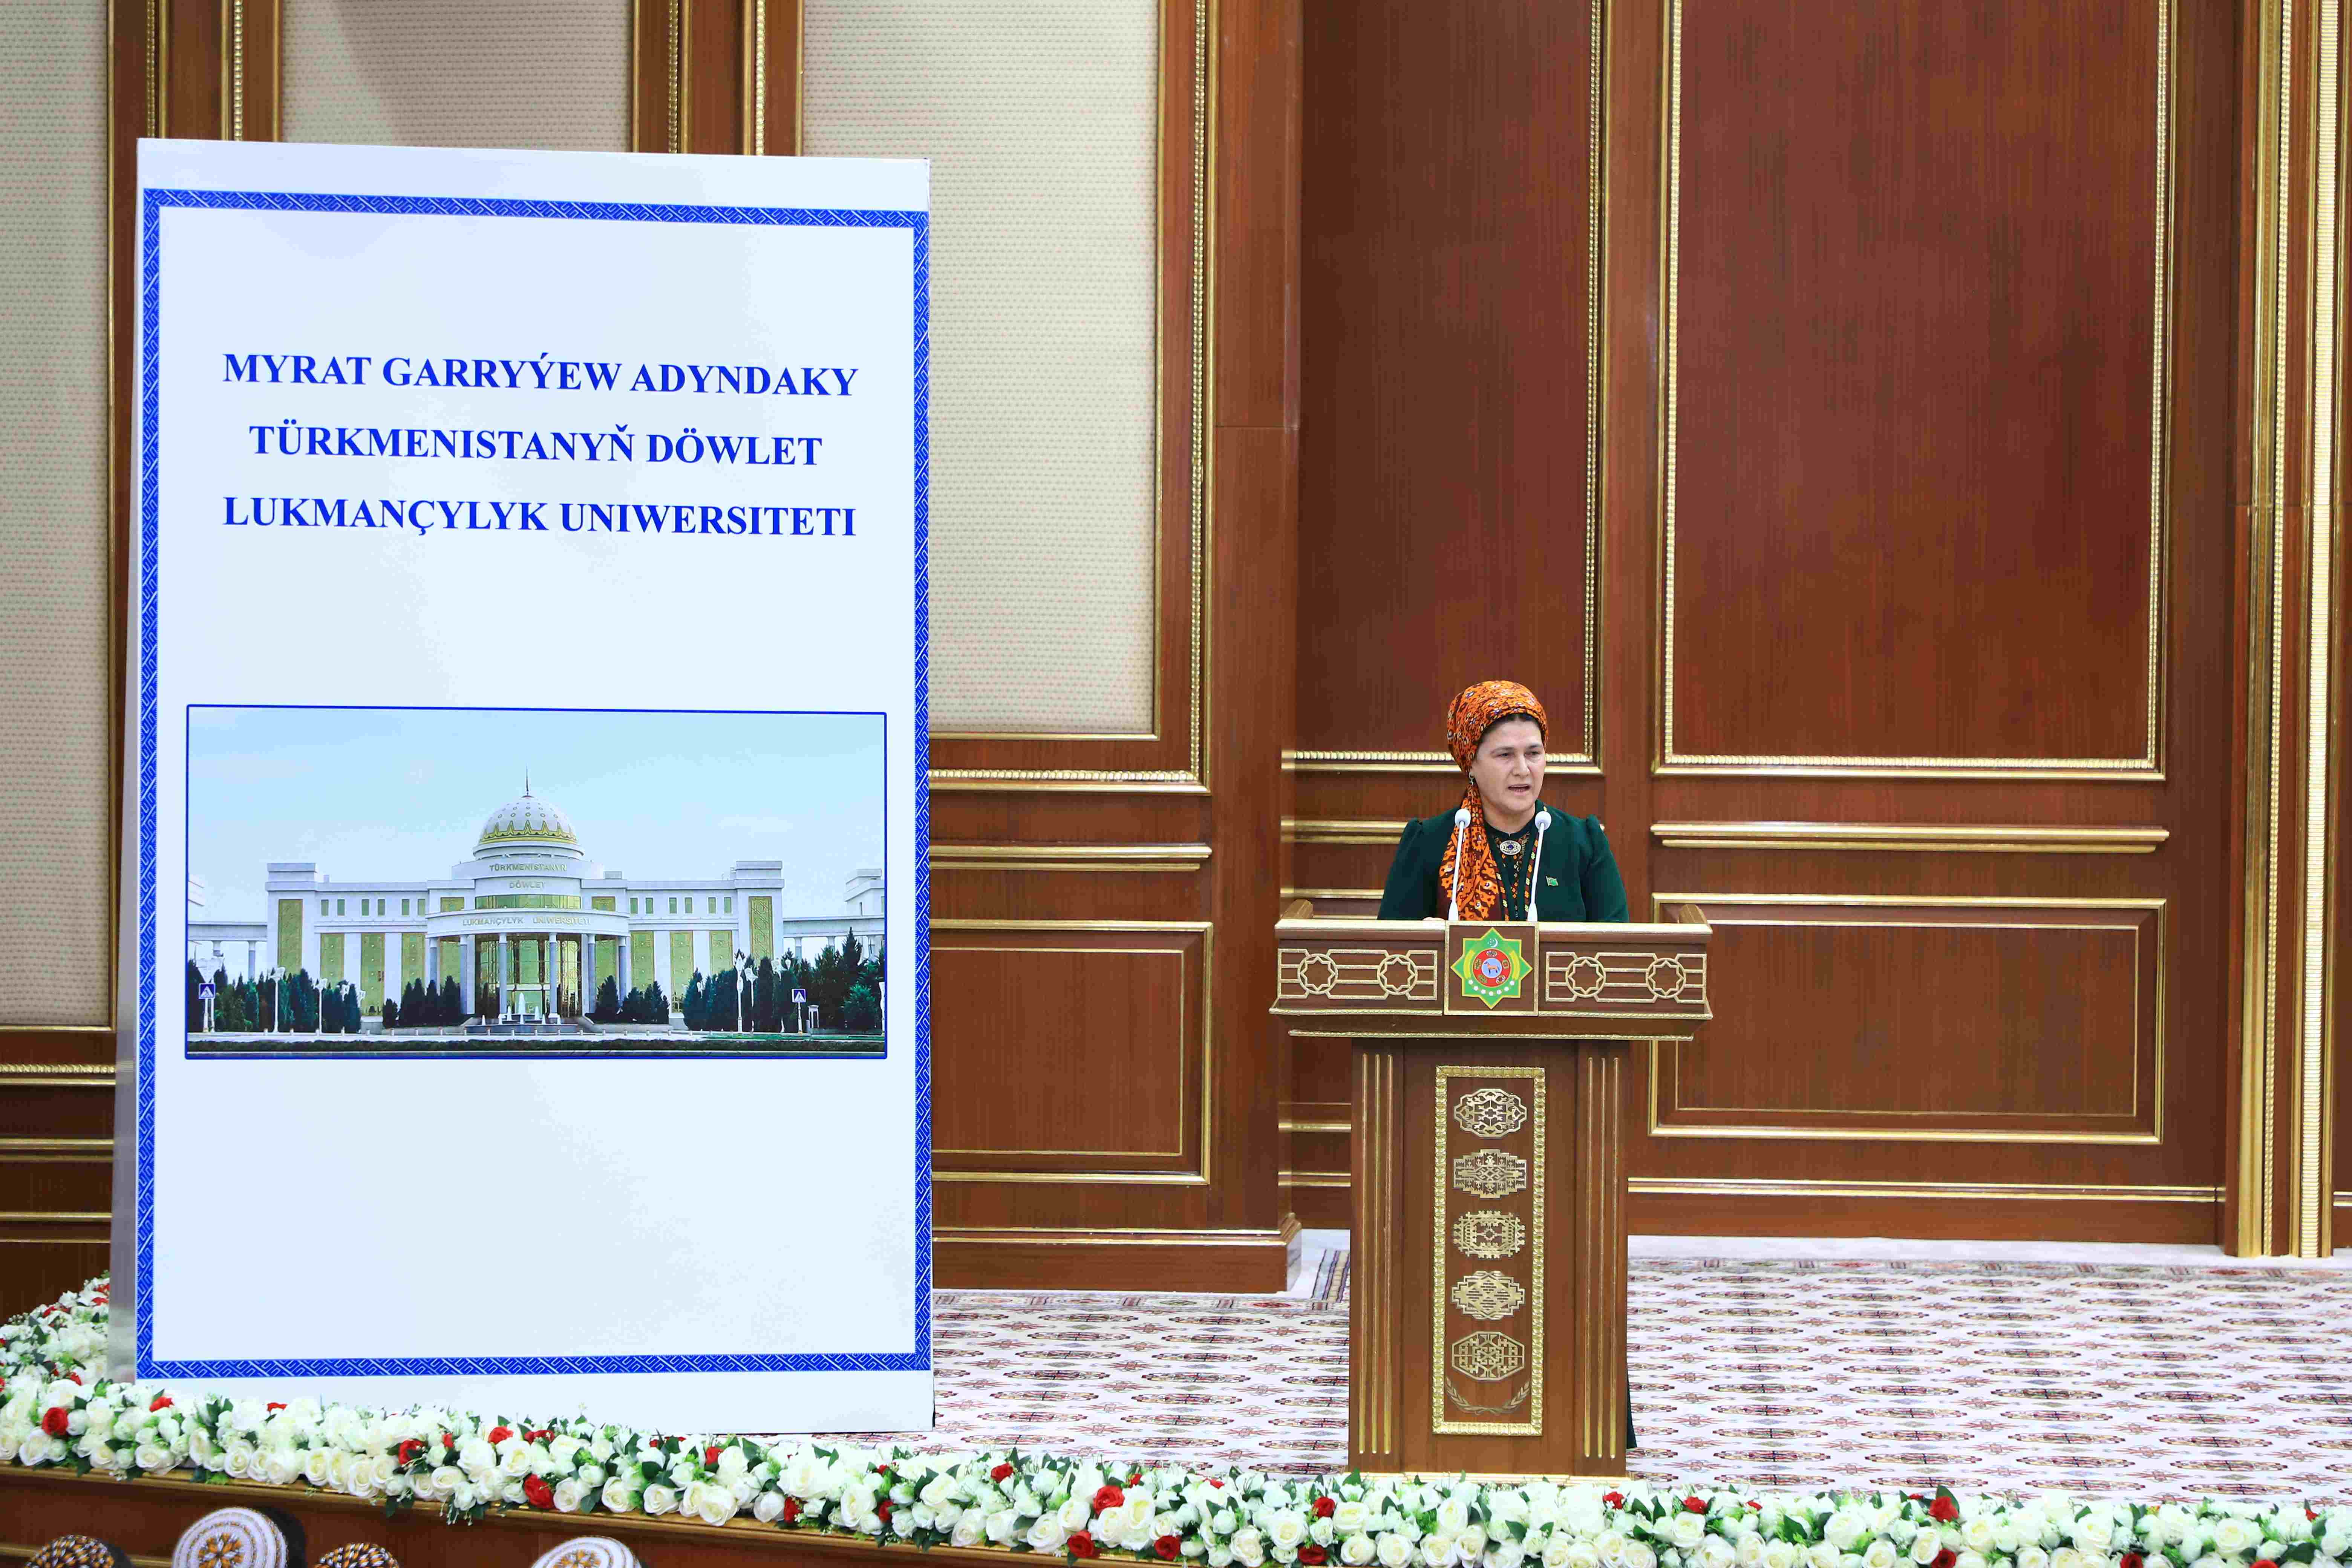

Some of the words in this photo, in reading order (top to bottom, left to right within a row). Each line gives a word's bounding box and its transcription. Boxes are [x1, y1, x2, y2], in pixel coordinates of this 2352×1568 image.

[223, 354, 371, 384] MYRAT
[383, 352, 622, 390] GARRYÝEW
[630, 364, 858, 396] ADYNDAKY
[249, 419, 635, 461] TÜRKMENISTANYŇ
[647, 428, 822, 465] DÖWLET
[223, 497, 548, 536] LUKMANÇYLYK
[560, 503, 856, 536] UNIWERSITETI
